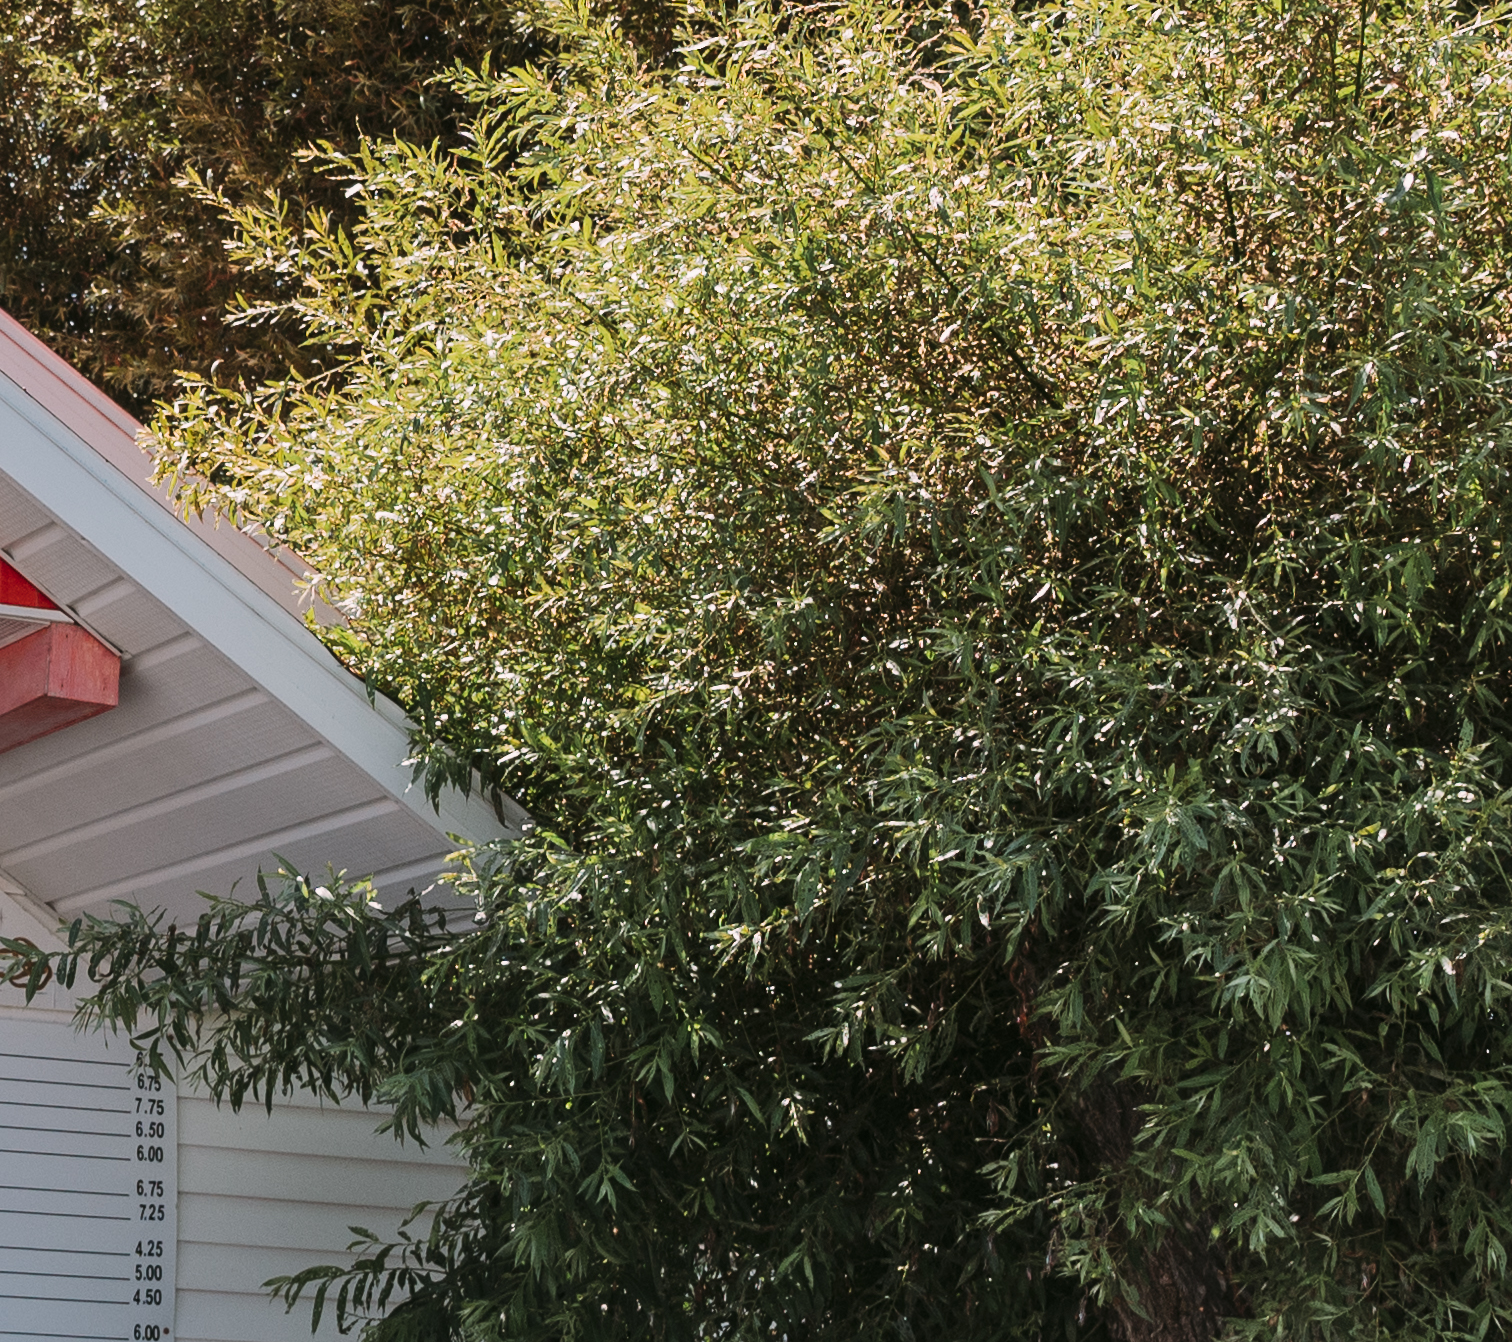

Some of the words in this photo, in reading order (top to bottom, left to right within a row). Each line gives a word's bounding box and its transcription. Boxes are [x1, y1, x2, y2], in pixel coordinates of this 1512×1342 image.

[137, 1073, 162, 1092] 6.75
[135, 1097, 164, 1115] 7.75
[136, 1121, 164, 1138] 6.50
[137, 1179, 163, 1197] 6.75
[135, 1240, 163, 1257] 4.25
[134, 1324, 160, 1341] 6.00
